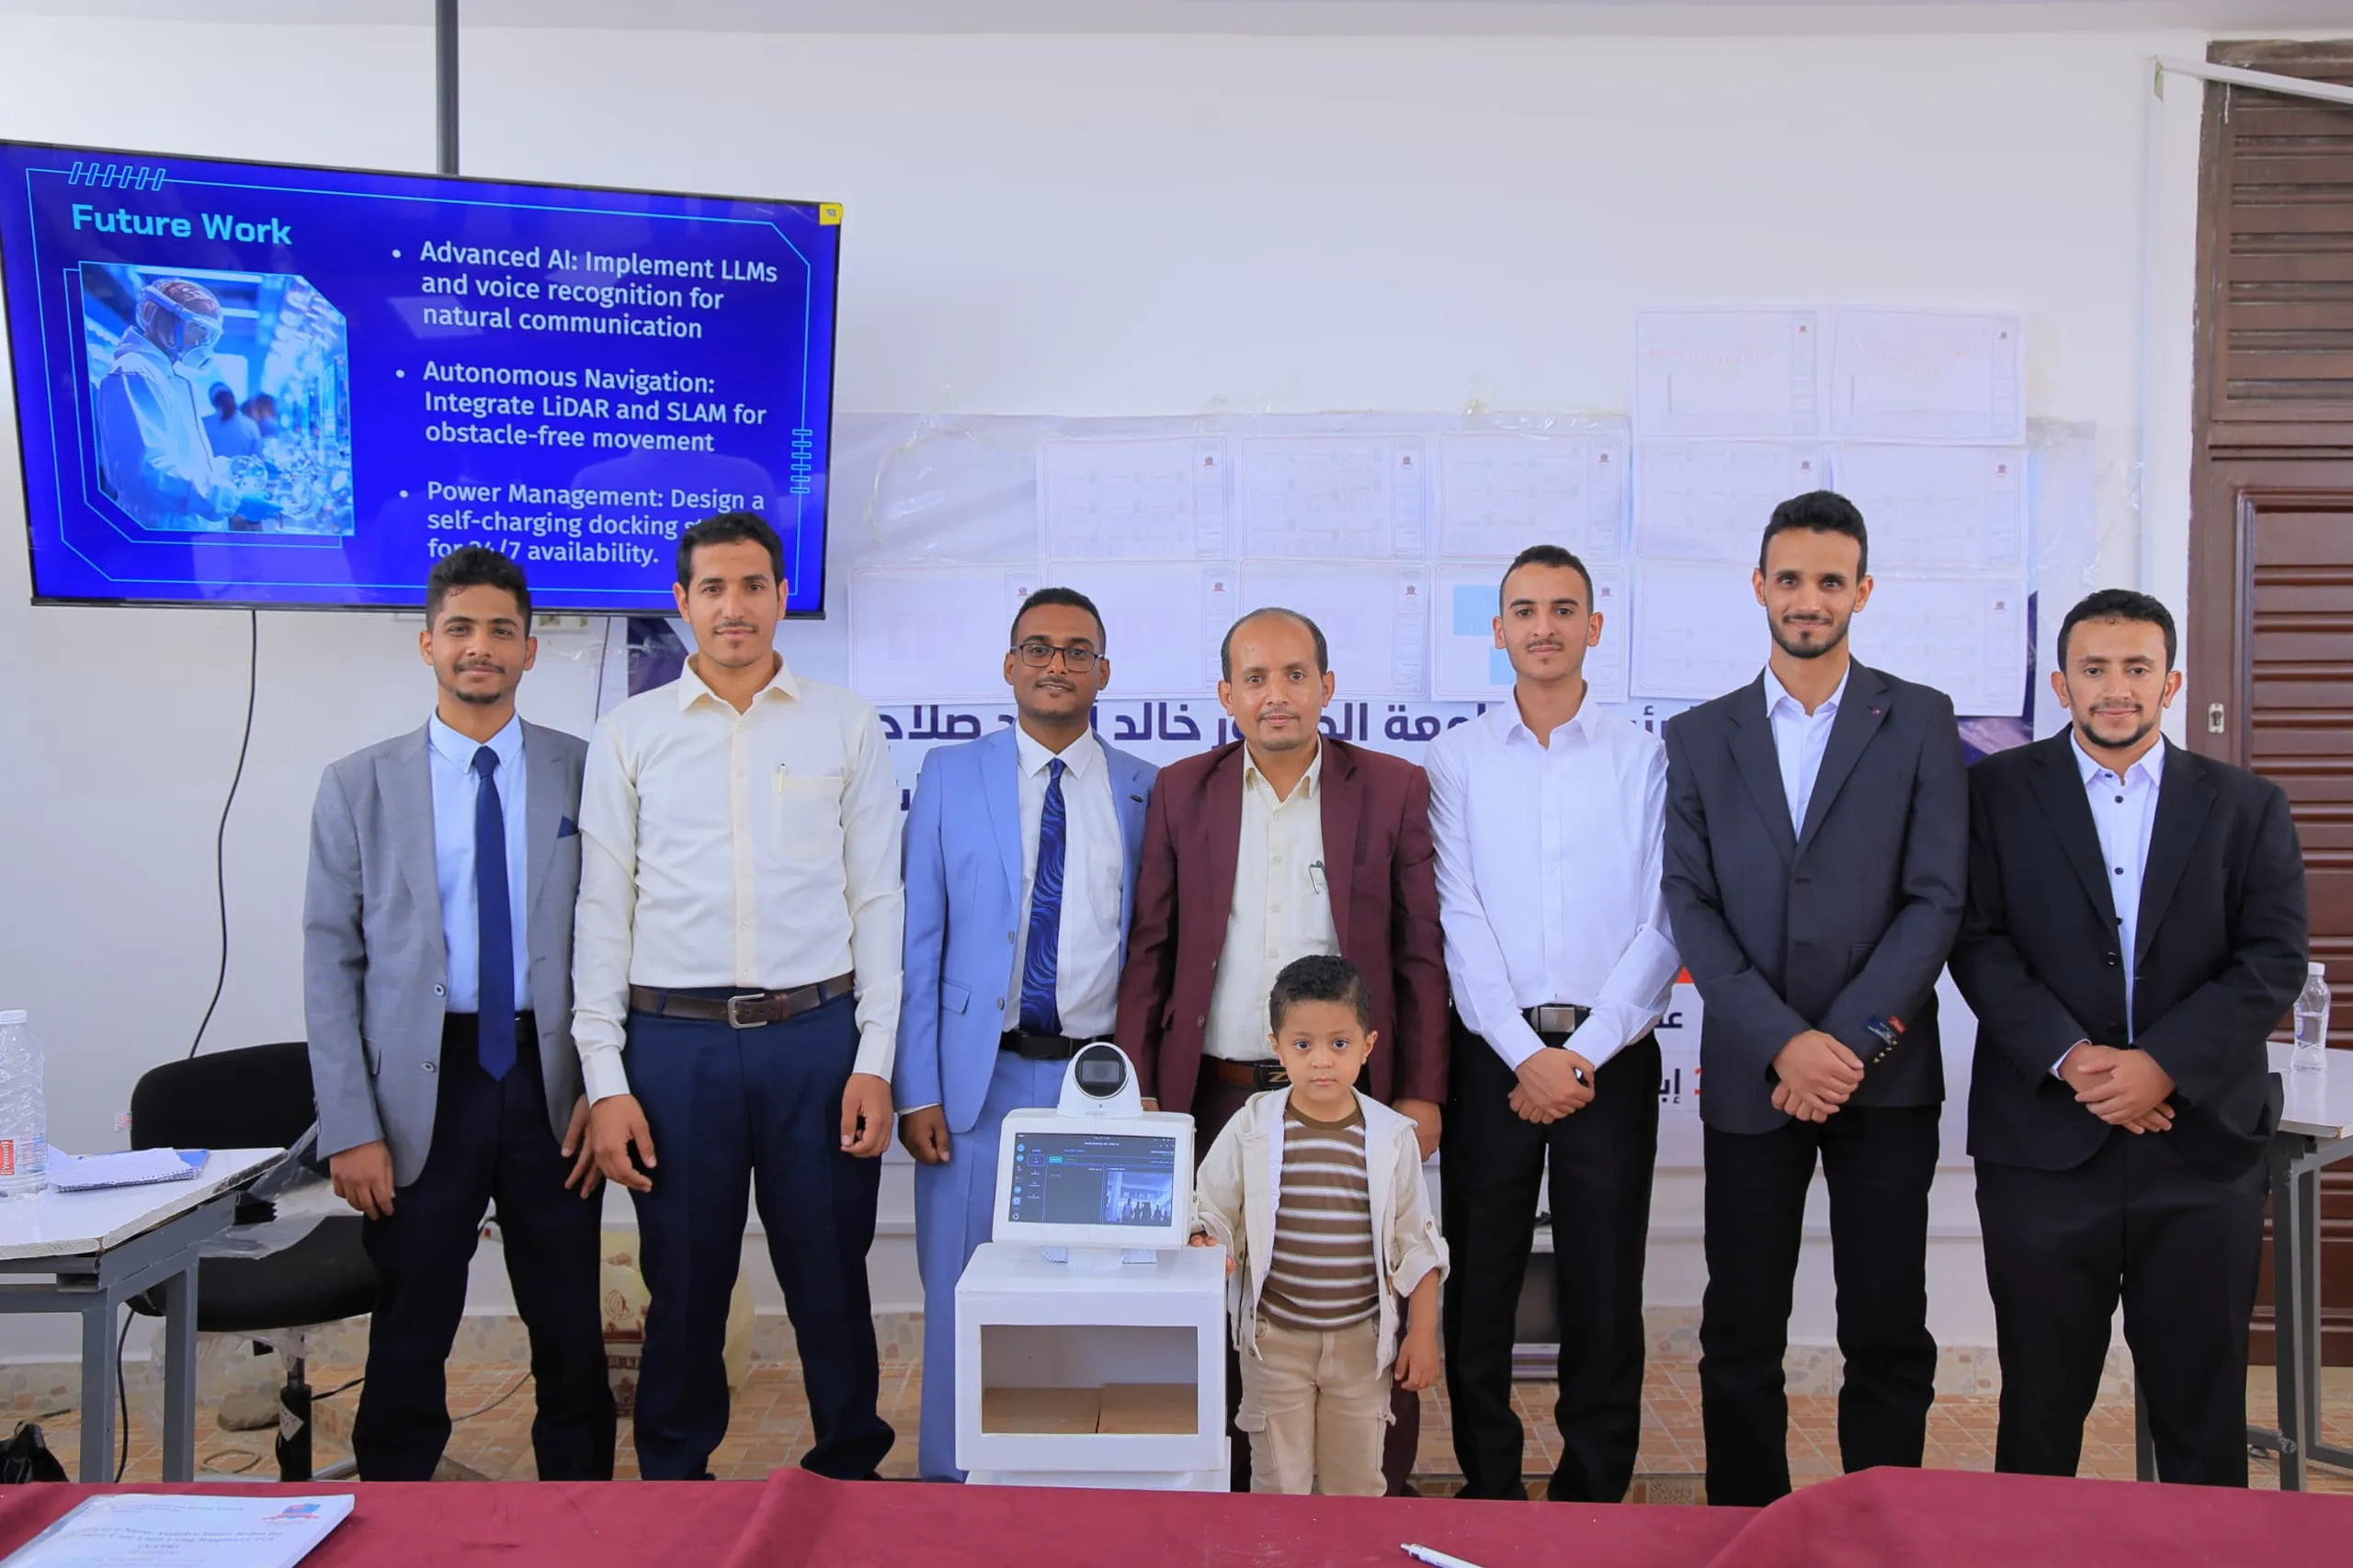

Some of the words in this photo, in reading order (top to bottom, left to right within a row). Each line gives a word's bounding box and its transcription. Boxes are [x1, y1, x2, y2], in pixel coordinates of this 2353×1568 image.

[72, 203, 192, 238] Future
[201, 212, 293, 245] Work
[420, 241, 540, 268] Advanced
[548, 249, 578, 270] AI:
[586, 251, 714, 279] Implement
[721, 259, 778, 282] LLMs
[421, 274, 468, 296] and
[475, 276, 540, 300] voice
[548, 282, 682, 308] recognition
[689, 288, 724, 309] for
[423, 305, 512, 329] natural
[519, 312, 702, 338] communication
[423, 360, 577, 388] Autonomous
[585, 369, 715, 395] Navigation:
[426, 392, 535, 417] Integrate
[542, 394, 609, 418] LiDAR
[616, 400, 660, 421] and
[666, 402, 726, 423] SLAM
[733, 403, 767, 425] for
[426, 421, 585, 448] obstacle-free
[593, 431, 715, 452] movement
[427, 481, 501, 503] Power
[508, 483, 665, 509] Management:
[671, 489, 745, 513] Design
[752, 493, 765, 510] a
[427, 510, 582, 537] self-charging
[588, 514, 678, 540] docking
[426, 538, 463, 558] for
[528, 542, 659, 567] availability.
[1113, 701, 1201, 741] خالد
